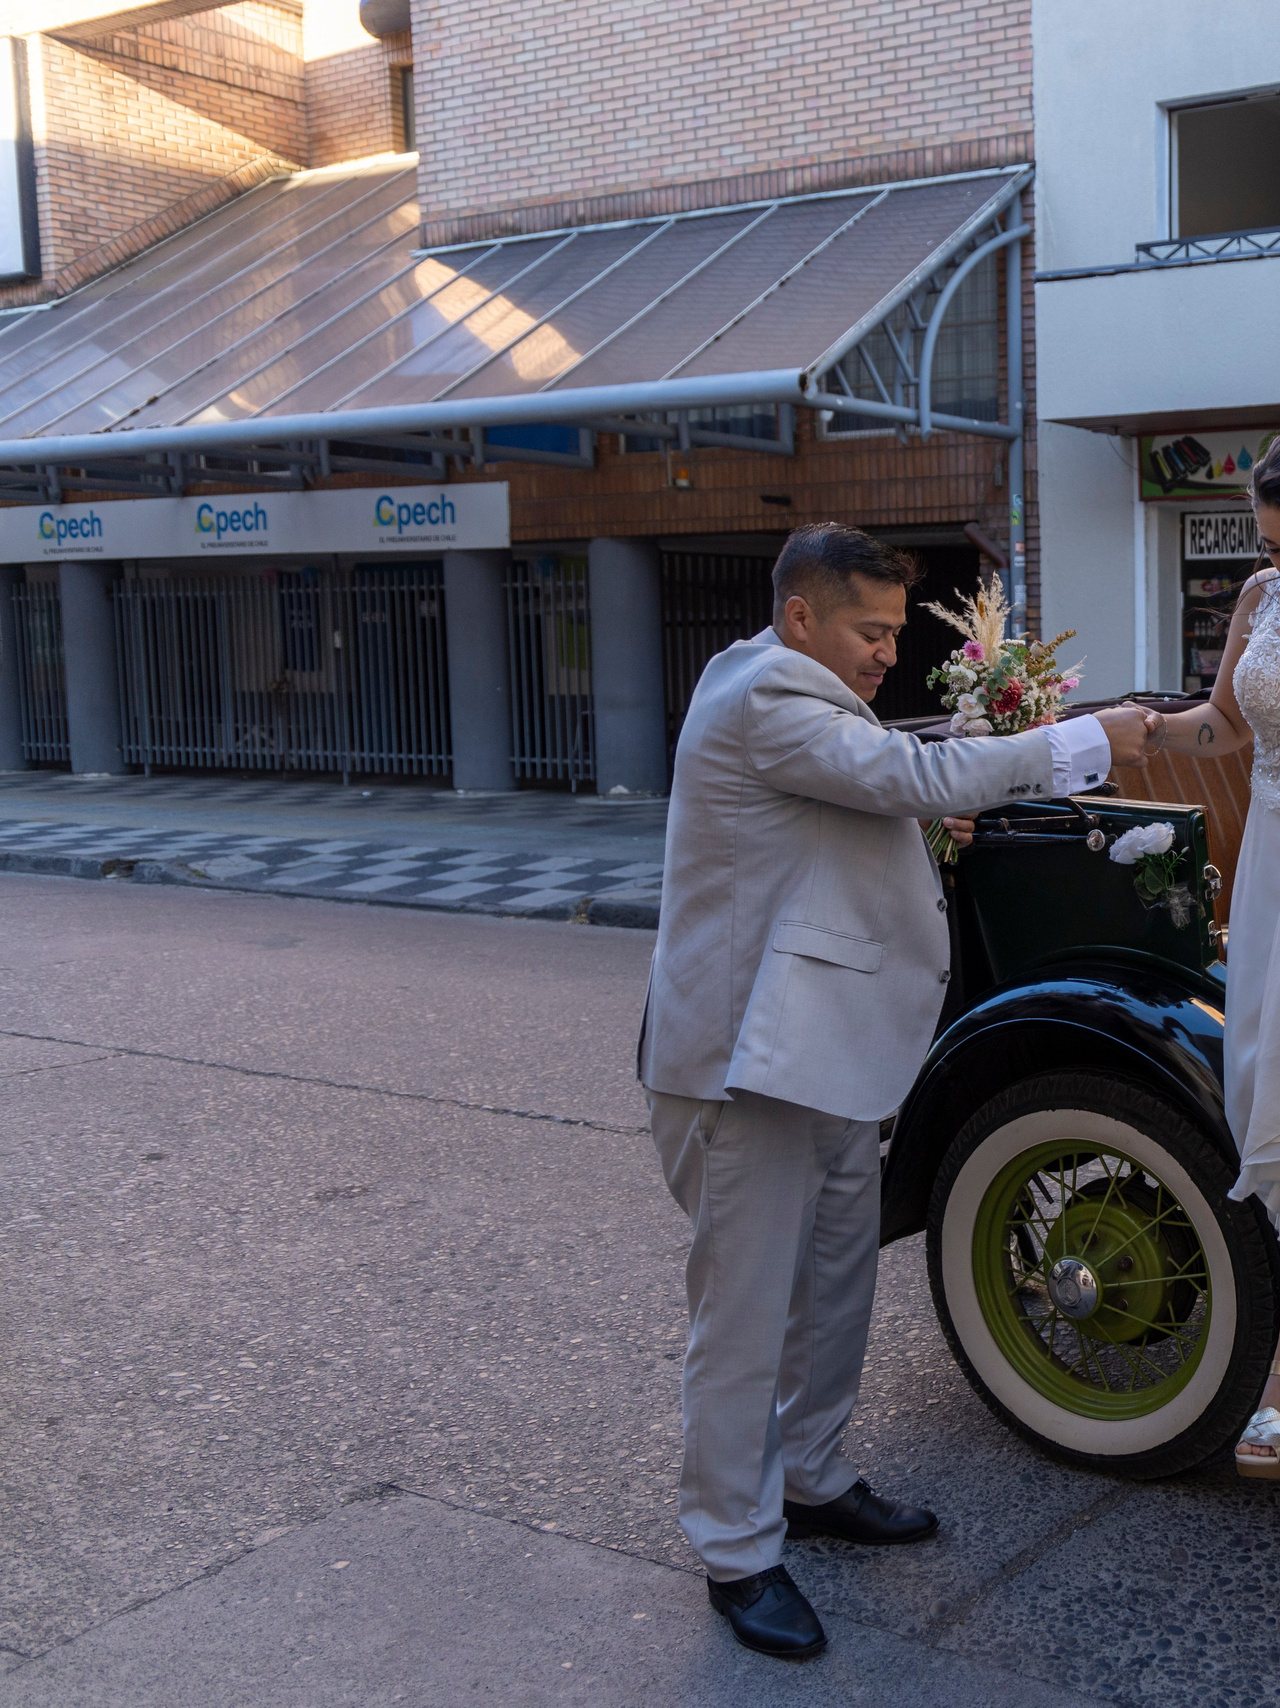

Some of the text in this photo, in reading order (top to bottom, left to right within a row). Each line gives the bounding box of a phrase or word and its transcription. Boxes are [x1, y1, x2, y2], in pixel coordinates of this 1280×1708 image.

[39, 509, 102, 546] Cpech
[197, 501, 267, 540] Cpech
[375, 493, 456, 534] Cpech
